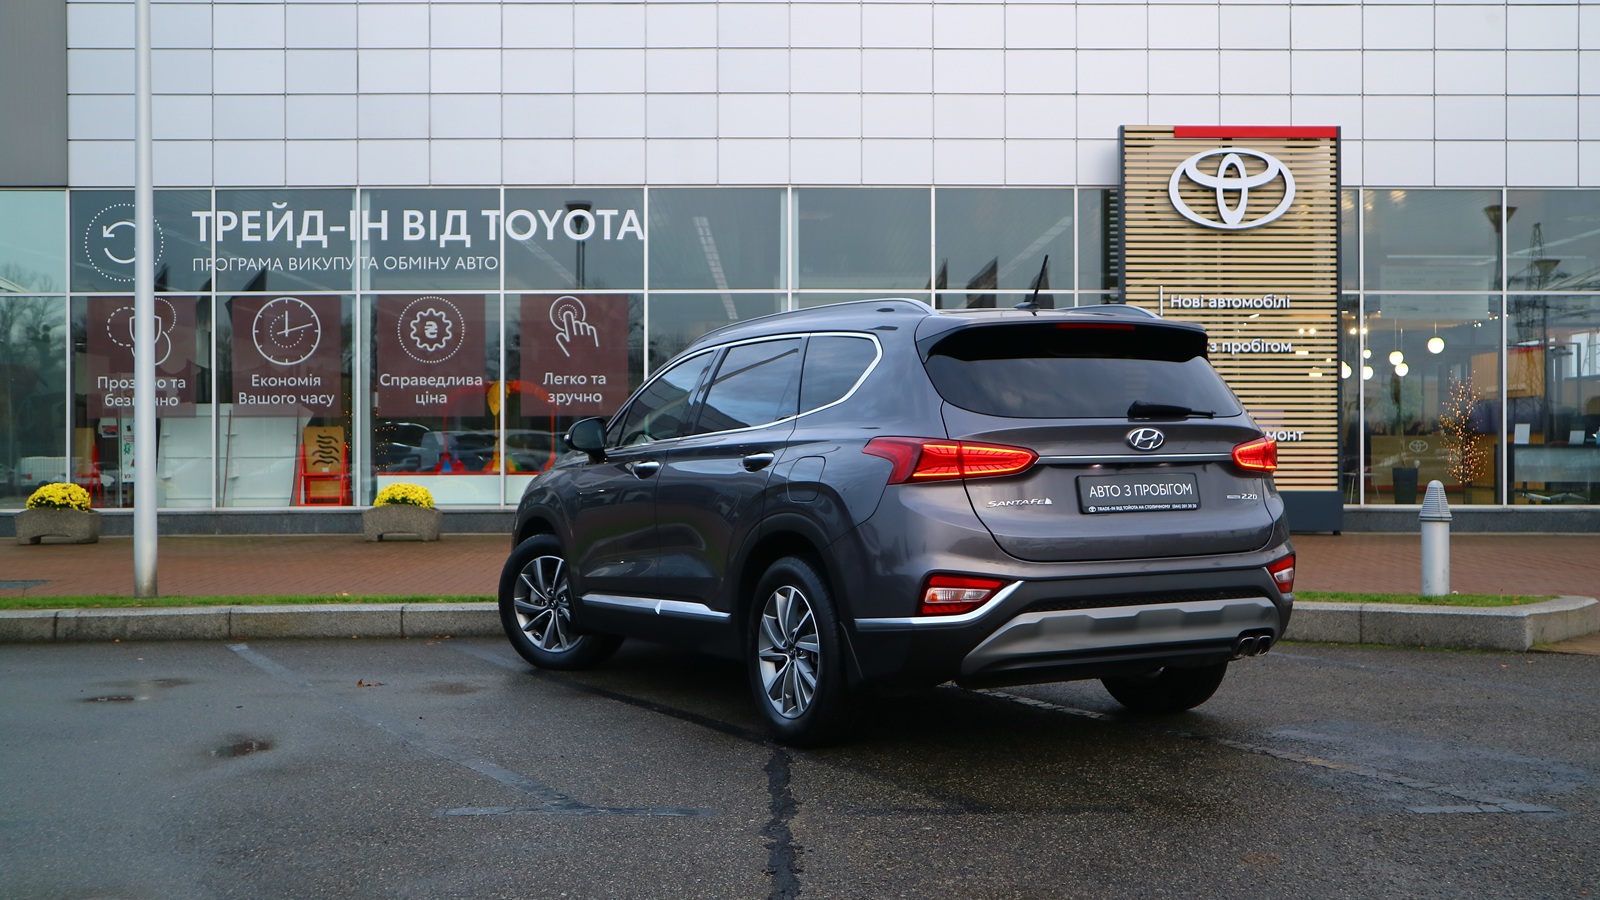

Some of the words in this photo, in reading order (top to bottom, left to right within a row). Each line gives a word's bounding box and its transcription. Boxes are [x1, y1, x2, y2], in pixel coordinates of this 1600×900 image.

[192, 202, 388, 248] ТРЕЙД-ІН
[403, 210, 471, 248] ВІД
[481, 209, 645, 241] TOYOTA
[193, 257, 283, 272] ПРОГРАМА
[289, 257, 356, 271] ВИКУПУ
[361, 256, 389, 270] ТА
[393, 256, 450, 270] ОБМІНУ
[455, 256, 498, 270] АВТО
[1171, 295, 1204, 308] Нові
[1208, 295, 1290, 308] автомобілі
[1222, 339, 1292, 355] пробігом
[97, 376, 167, 392] Прозо
[171, 378, 186, 389] та
[251, 374, 321, 387] Економія
[379, 374, 483, 388] Справедлива
[543, 373, 587, 386] Легко
[590, 375, 607, 386] та
[105, 393, 179, 407] безно
[238, 392, 297, 405] Вашого
[300, 394, 335, 407] часу
[415, 391, 448, 405] ціна
[548, 393, 603, 405] зручно
[1265, 430, 1304, 441] монт
[1089, 484, 1121, 498] АВТО
[1134, 482, 1193, 496] ПРОБІГОМ
